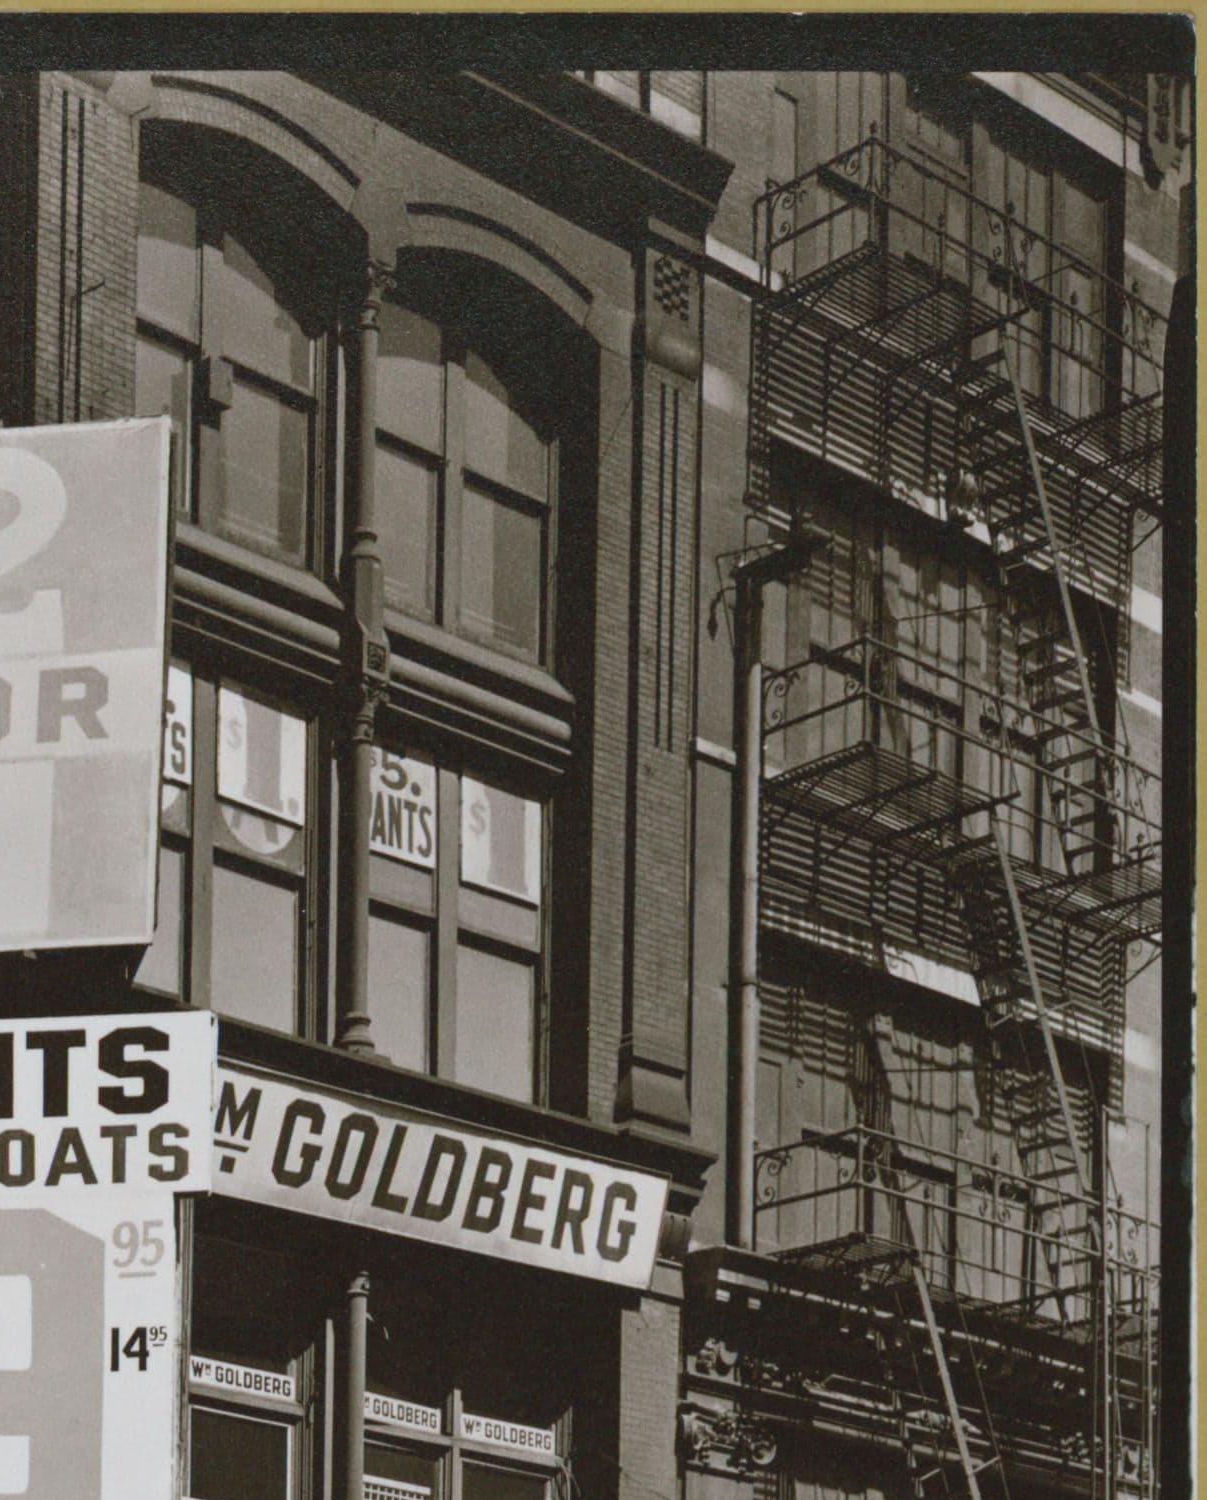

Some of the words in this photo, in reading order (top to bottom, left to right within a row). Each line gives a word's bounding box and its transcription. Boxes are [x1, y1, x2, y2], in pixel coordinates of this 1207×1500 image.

[370, 791, 433, 859] ANTS
[271, 1098, 638, 1263] GOLDBERG
[215, 1366, 292, 1398] GOLDBERG
[373, 1396, 438, 1431] GOLDBERG
[484, 1422, 552, 1451] GOLDBERG
